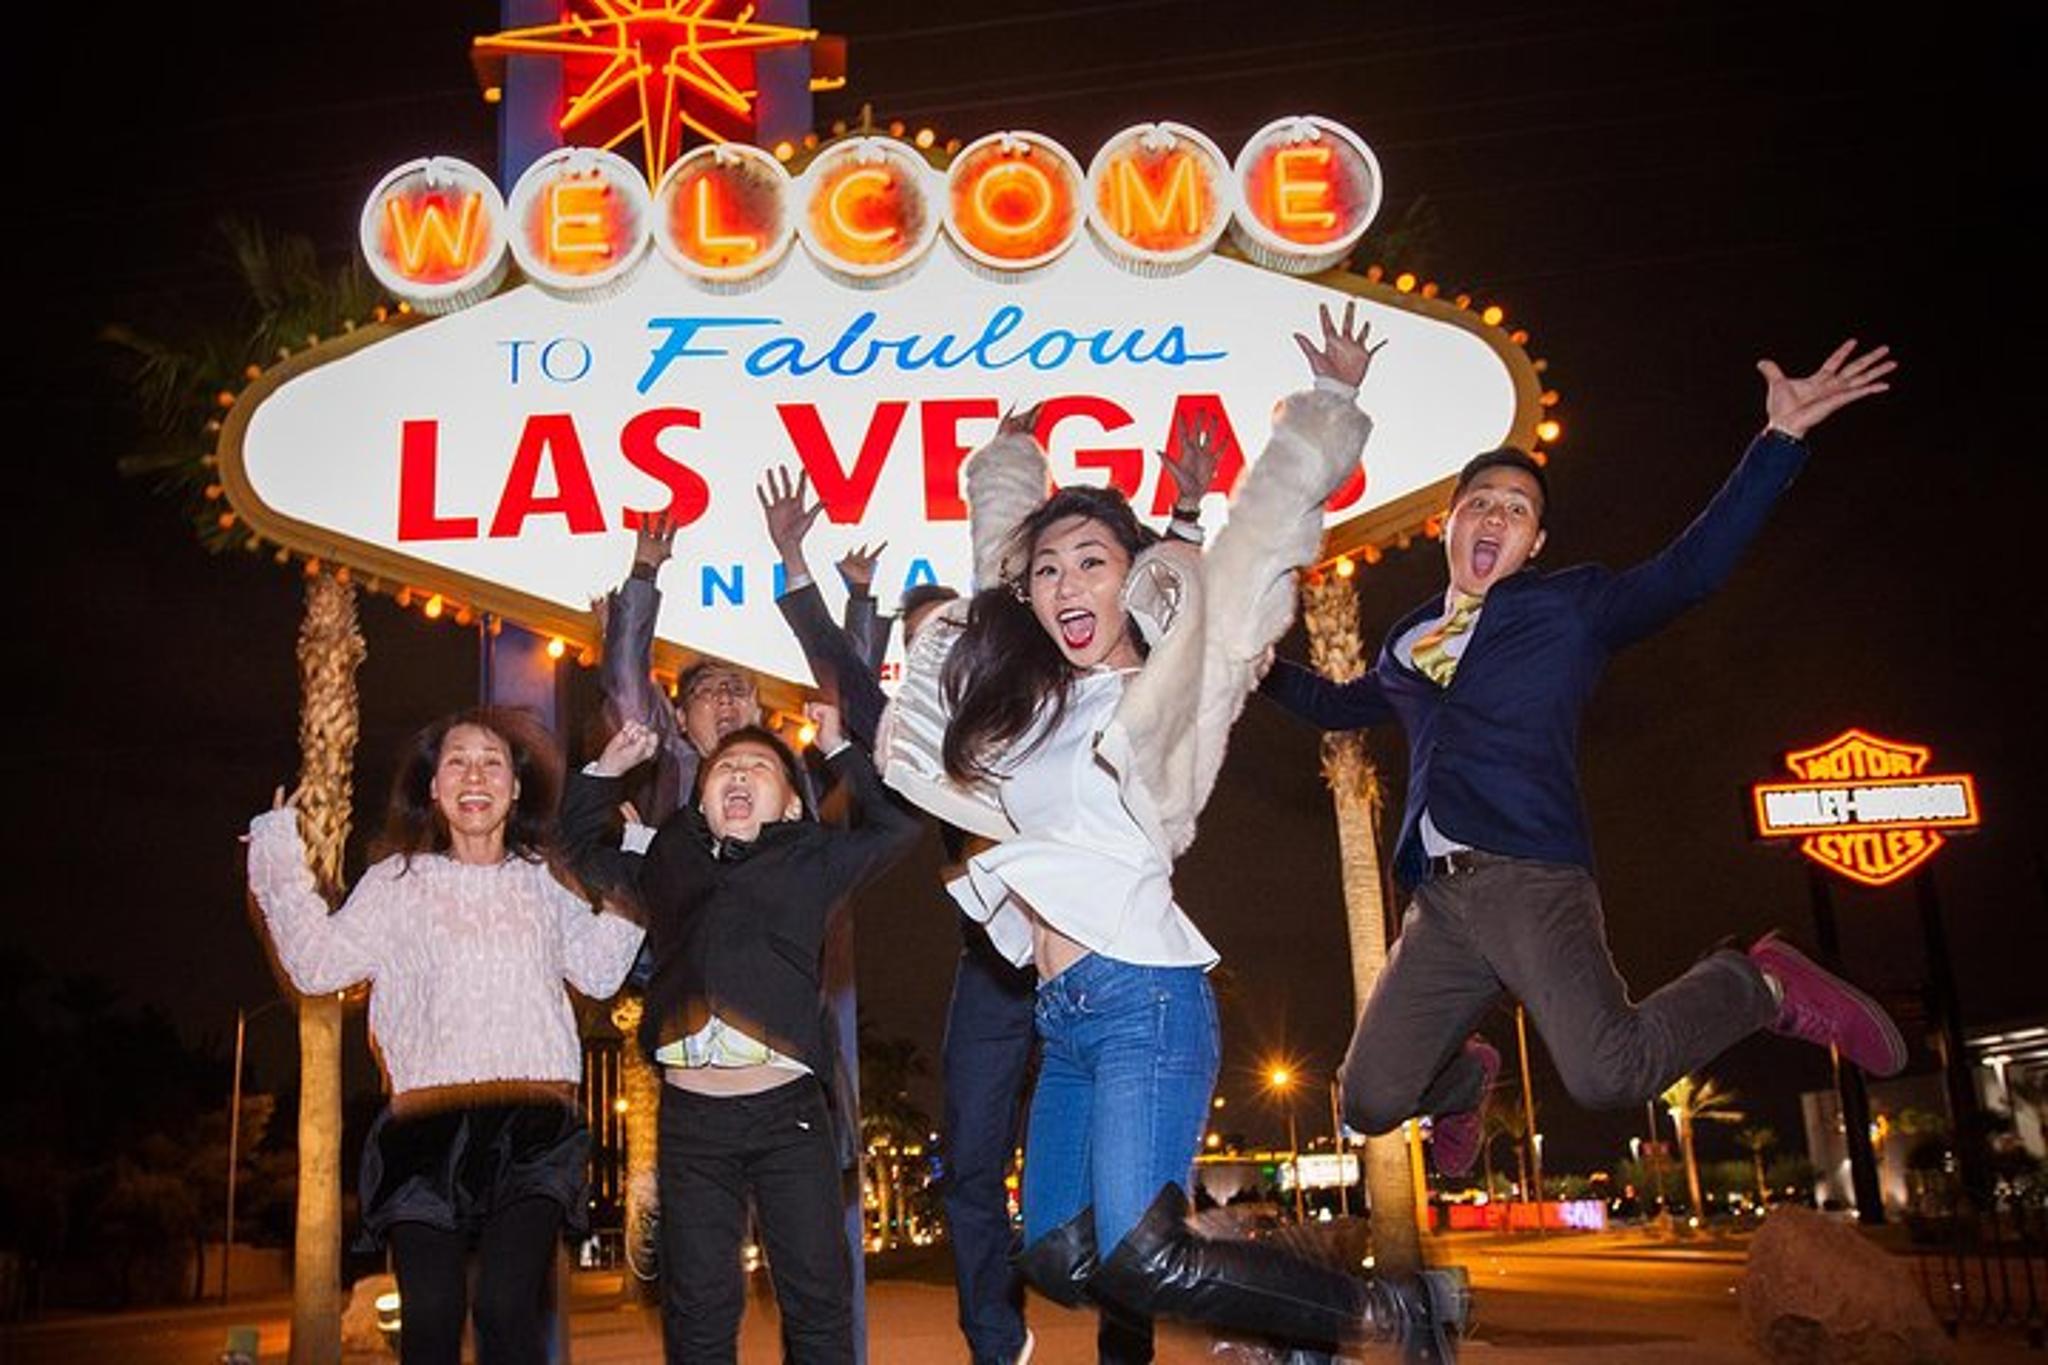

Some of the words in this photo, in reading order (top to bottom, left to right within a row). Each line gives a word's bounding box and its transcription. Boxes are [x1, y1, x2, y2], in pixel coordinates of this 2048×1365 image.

[384, 145, 1336, 275] WELCOME
[497, 339, 592, 384] TO
[635, 305, 1227, 394] Fabulous
[397, 407, 710, 541] LAS
[776, 393, 1367, 526] VEGA
[1805, 738, 1914, 780] MOTOR
[1817, 830, 1925, 875] CYCLES
